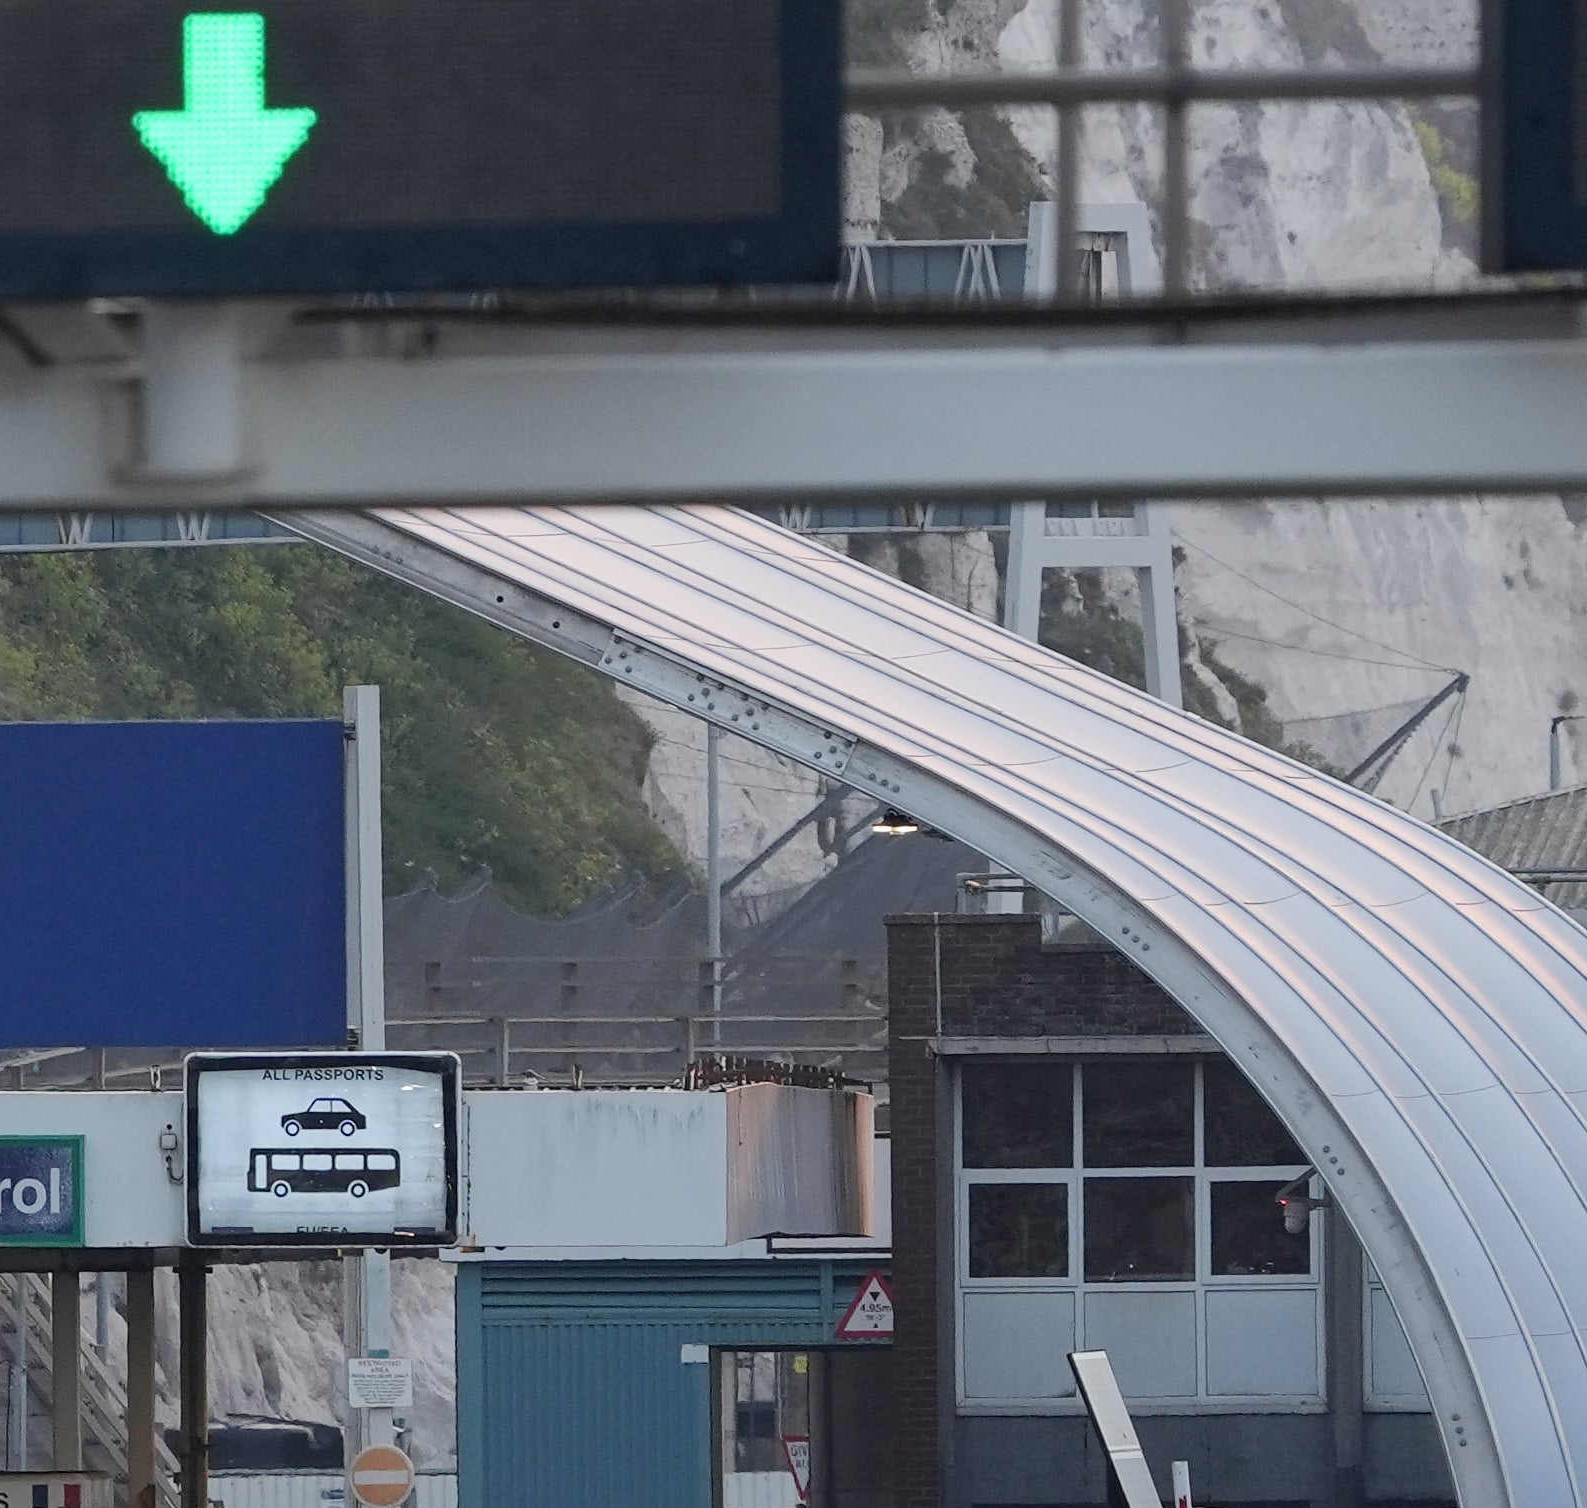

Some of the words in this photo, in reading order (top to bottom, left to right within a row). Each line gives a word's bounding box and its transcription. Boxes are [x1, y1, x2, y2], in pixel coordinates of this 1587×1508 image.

[262, 1069, 290, 1081] ALL
[294, 1068, 384, 1081] PASSPORTS
[859, 1303, 892, 1313] 4.95m
